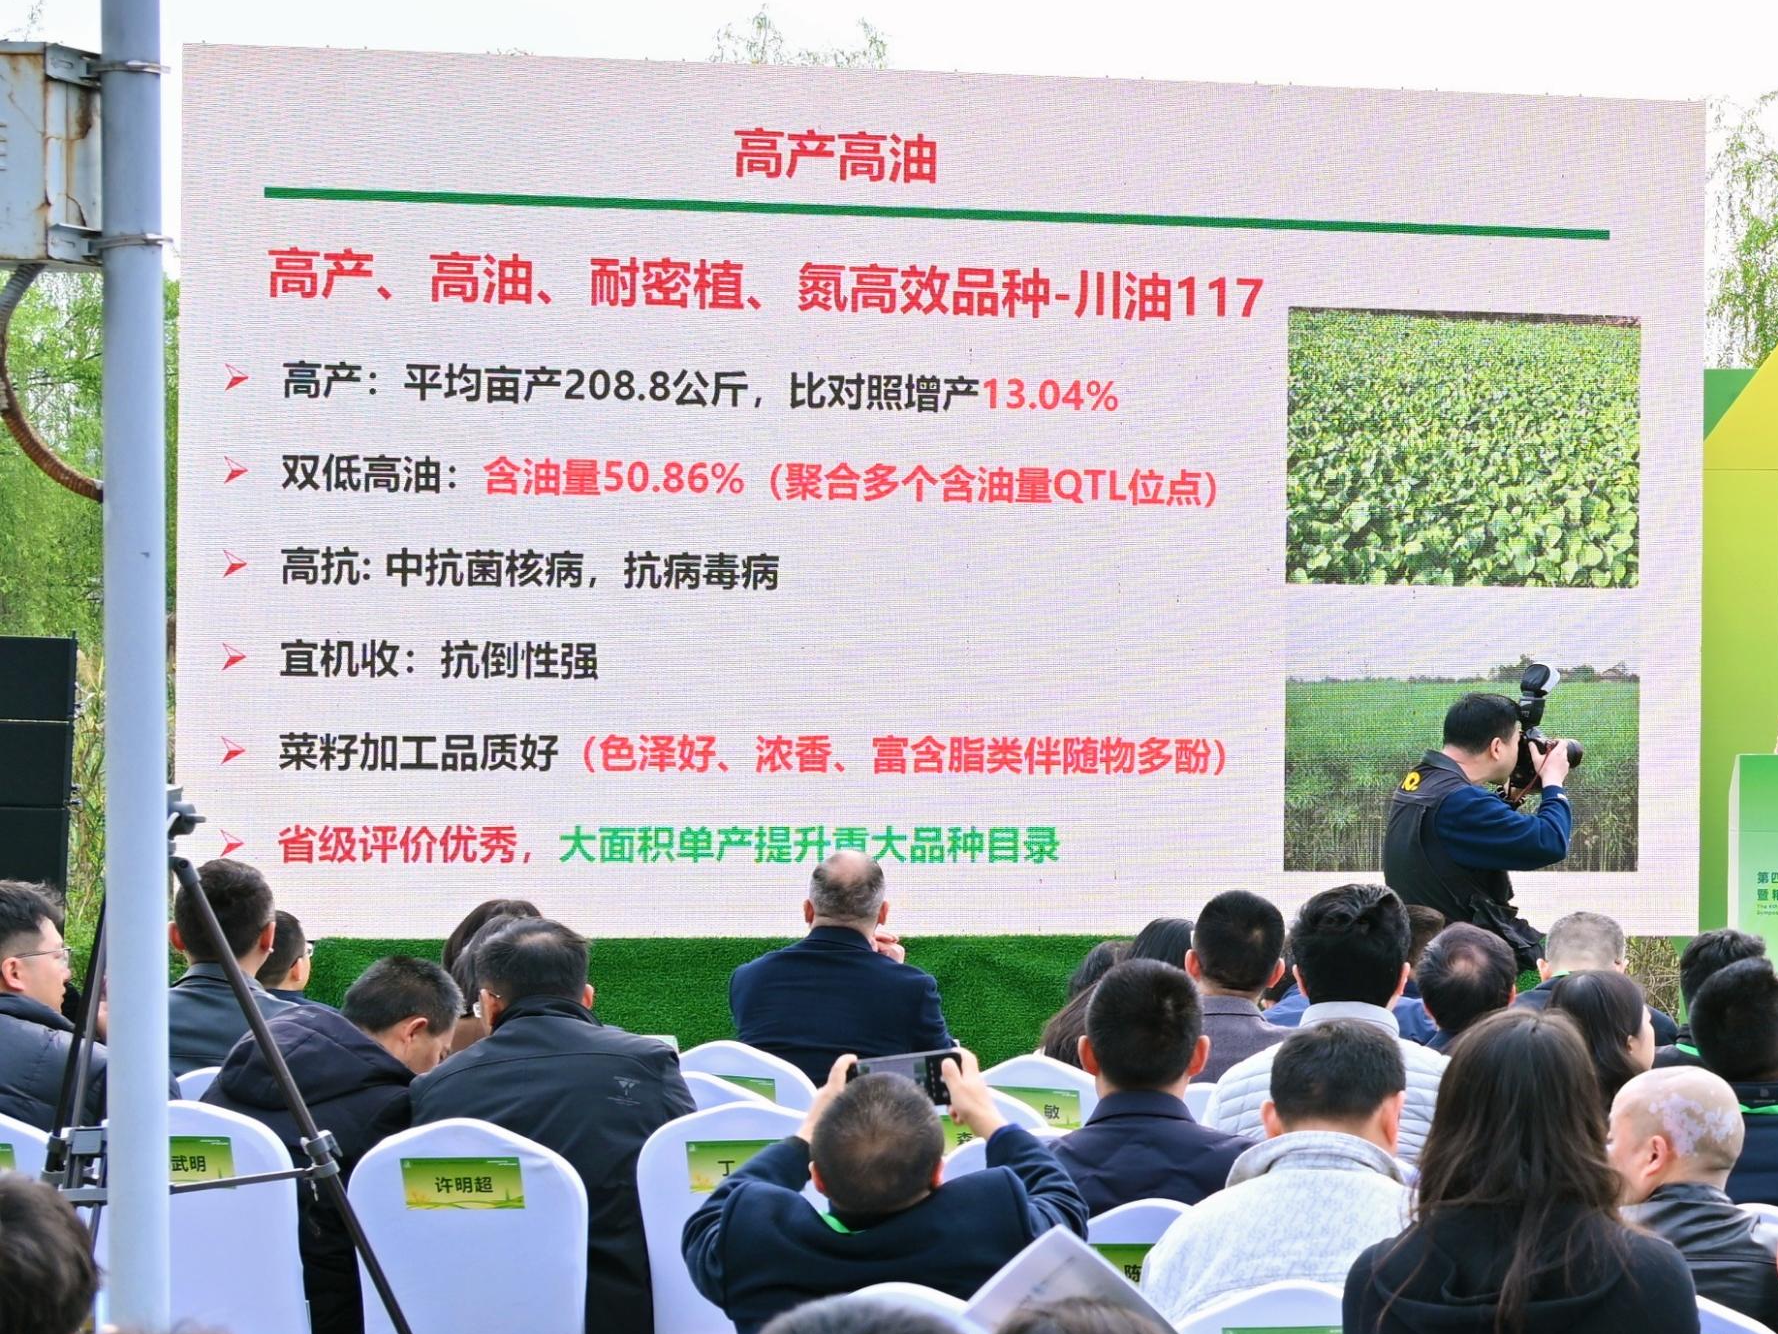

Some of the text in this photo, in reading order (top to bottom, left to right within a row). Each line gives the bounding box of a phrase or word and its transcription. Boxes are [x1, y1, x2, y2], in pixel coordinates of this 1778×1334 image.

[735, 128, 938, 184] 高产高油
[267, 246, 1265, 321] 高产、高油、耐密植、氮高效品种-川油117
[279, 639, 600, 681] 宜机收：抗倒性强
[434, 1176, 494, 1194] 许明超
